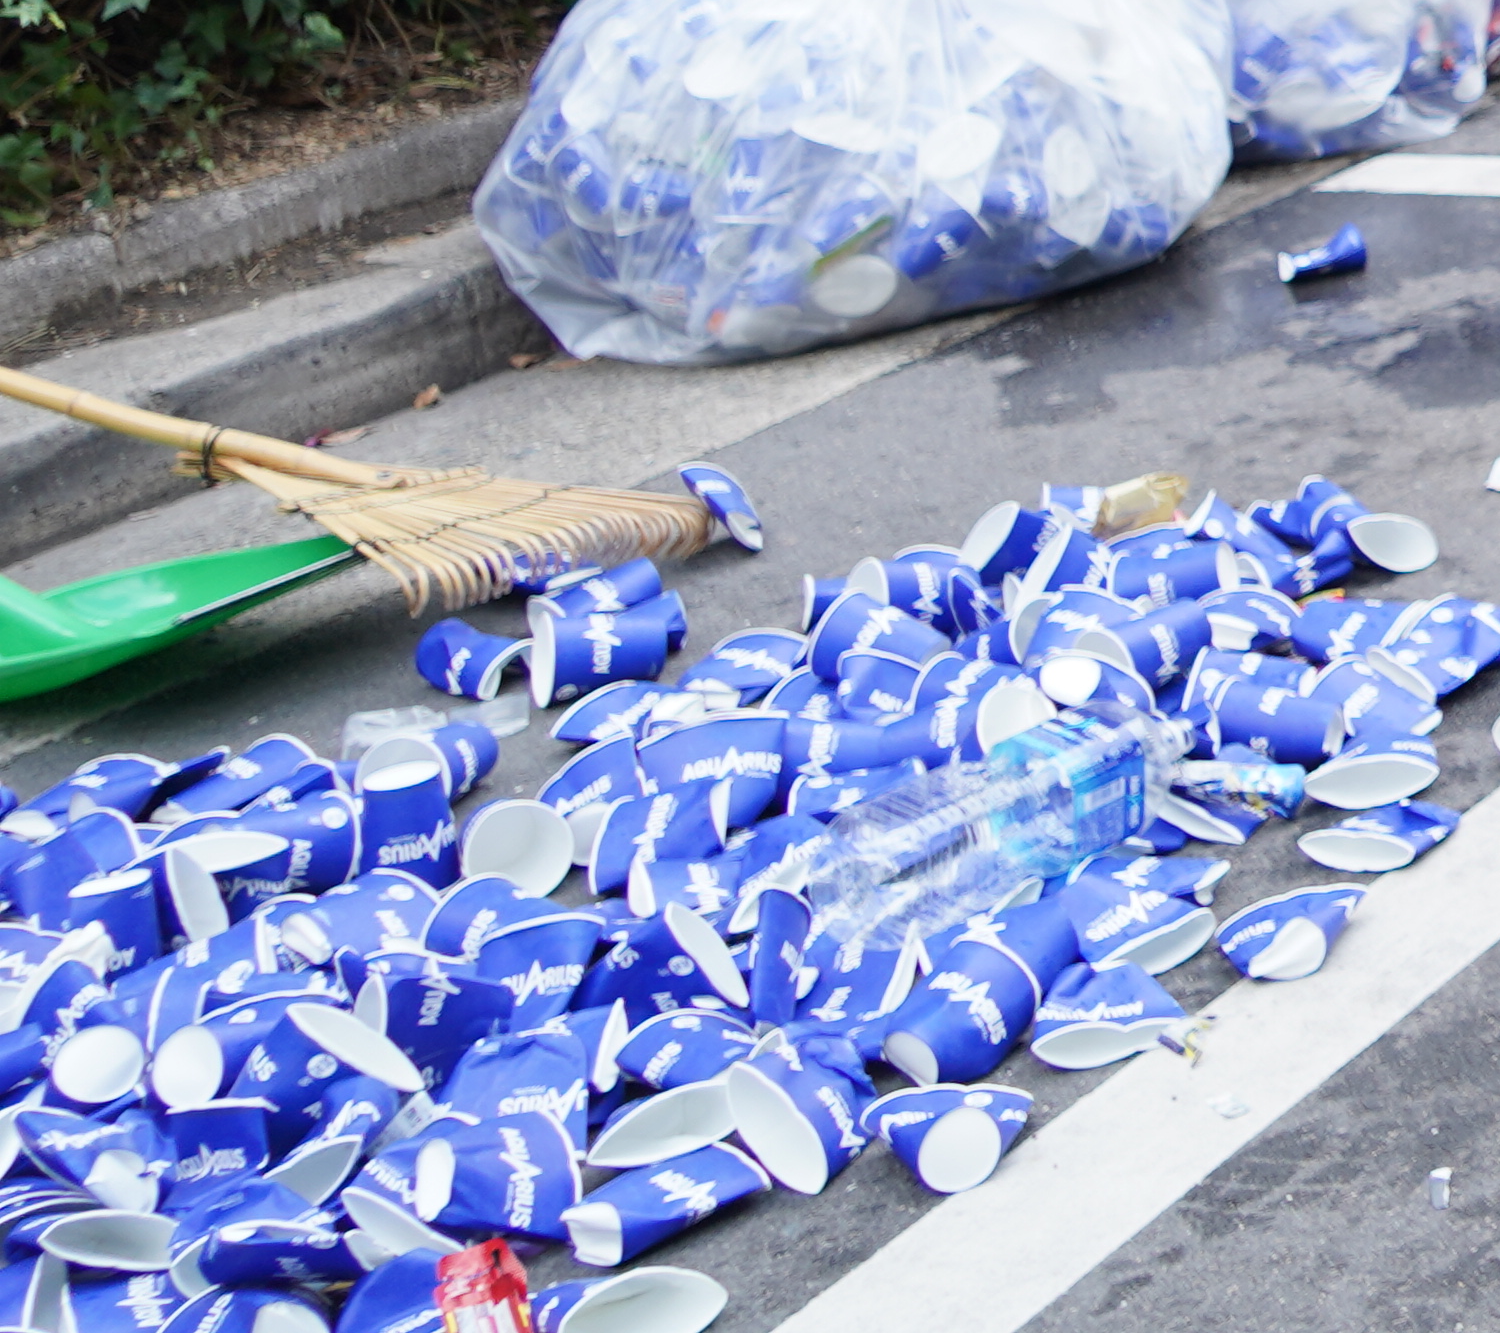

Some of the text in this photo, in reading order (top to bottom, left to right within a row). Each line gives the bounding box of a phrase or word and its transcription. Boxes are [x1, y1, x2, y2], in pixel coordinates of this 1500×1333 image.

[681, 745, 783, 782] AQUARIUS
[928, 970, 1008, 1045] AQUARIUS
[499, 1127, 543, 1230] AQUARIUS
